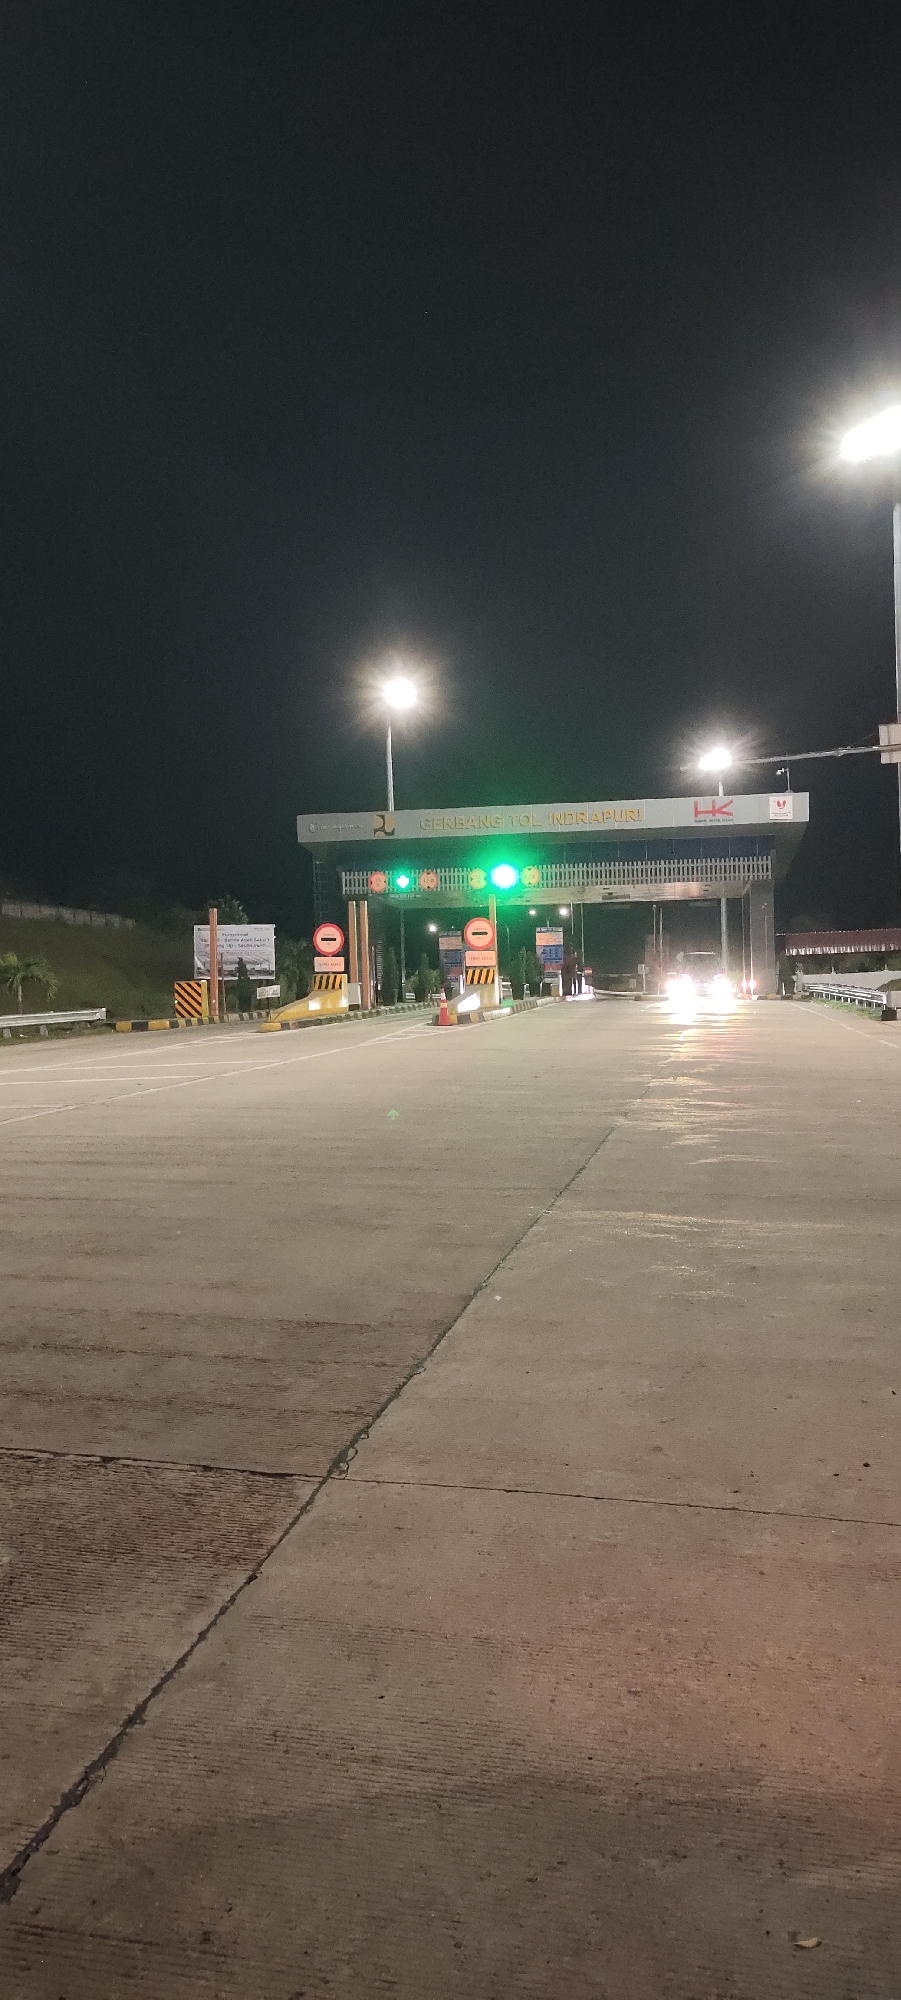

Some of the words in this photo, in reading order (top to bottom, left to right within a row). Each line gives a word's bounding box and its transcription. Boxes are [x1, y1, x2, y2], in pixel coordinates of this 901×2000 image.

[694, 799, 733, 818] HK
[419, 814, 503, 831] GERBANG
[508, 813, 542, 828] TOL
[549, 808, 642, 826] INDRAPURI
